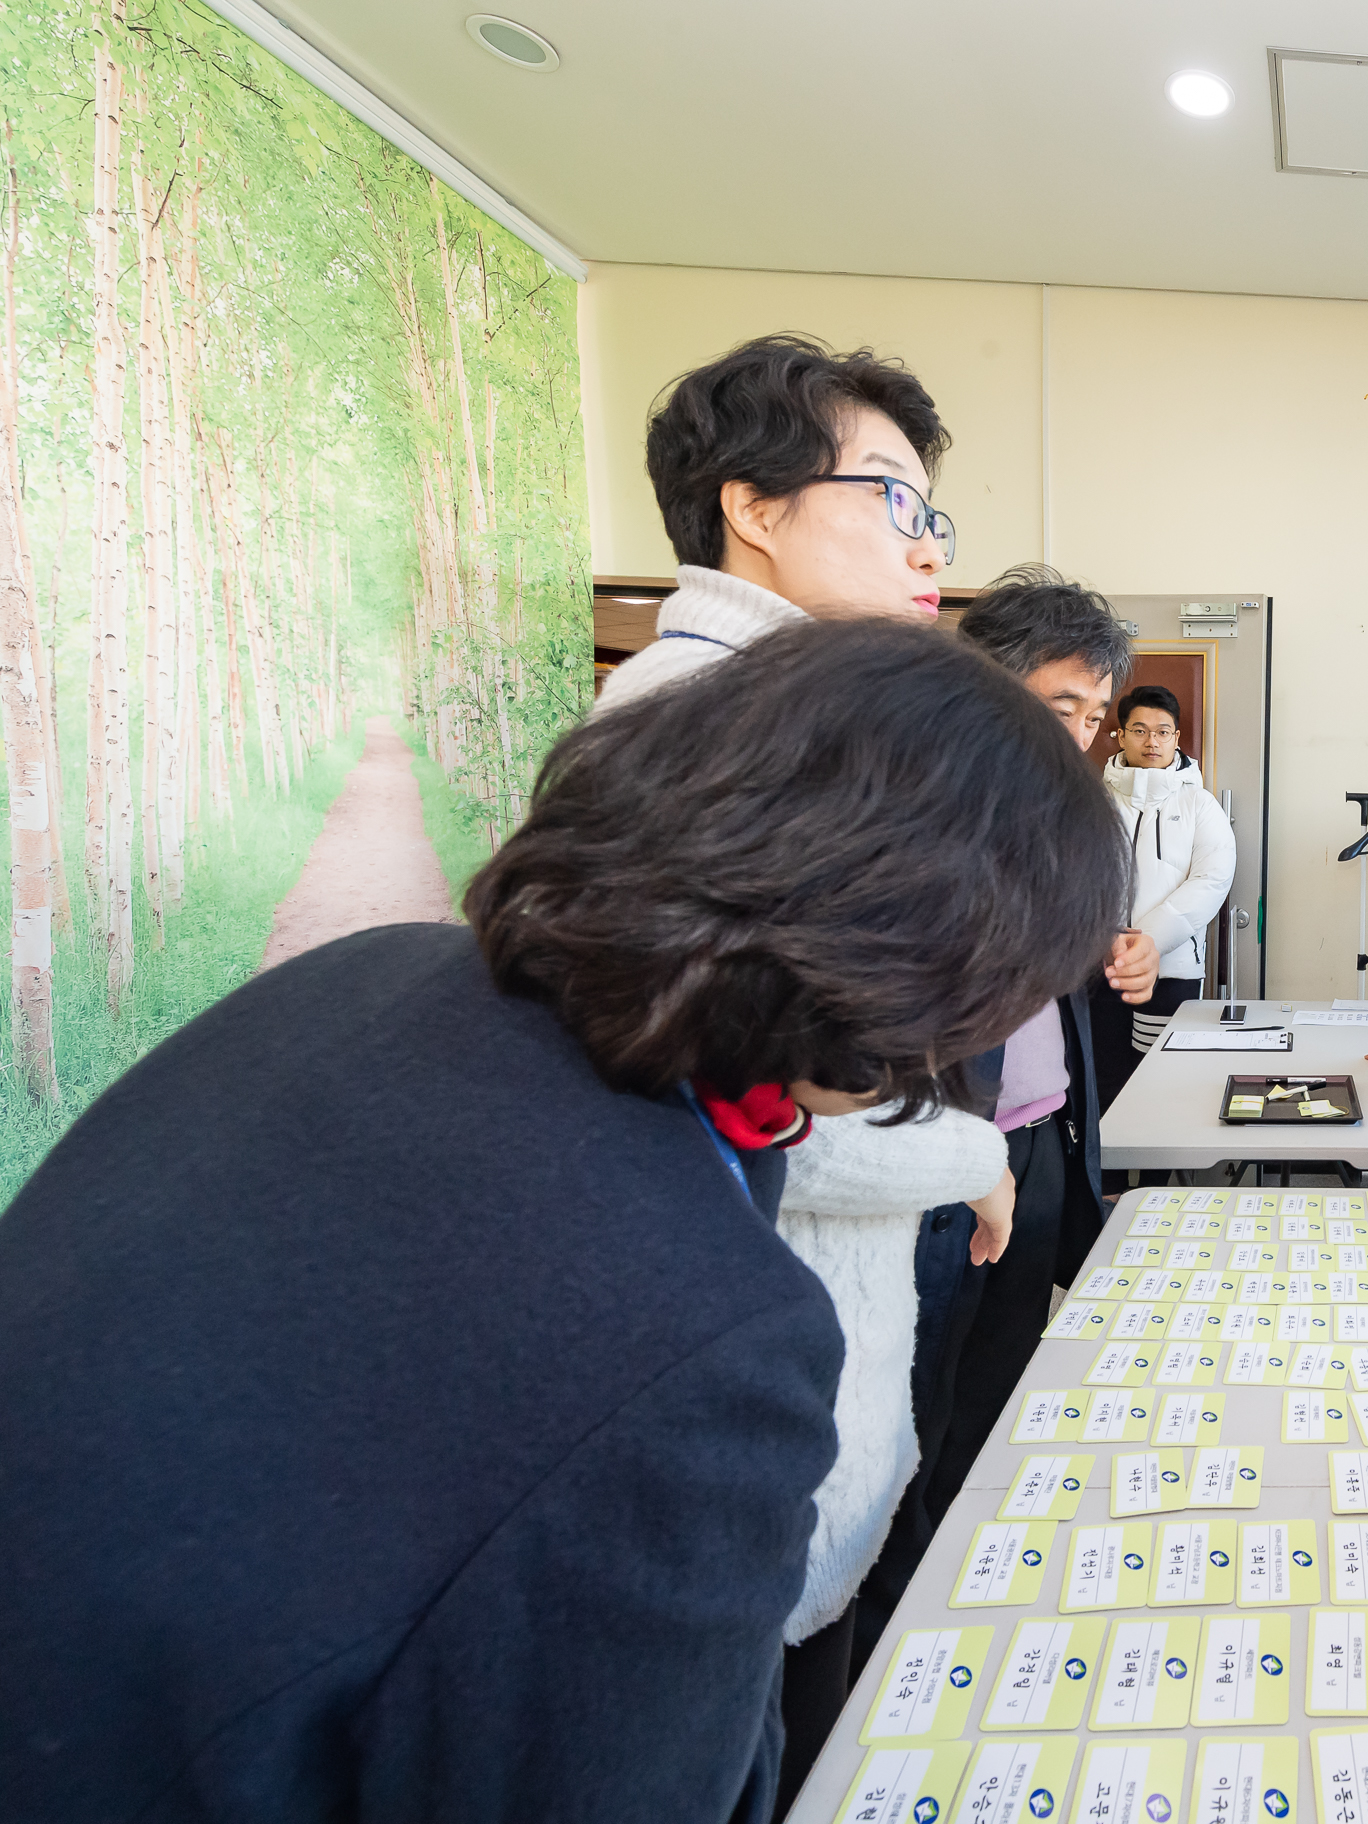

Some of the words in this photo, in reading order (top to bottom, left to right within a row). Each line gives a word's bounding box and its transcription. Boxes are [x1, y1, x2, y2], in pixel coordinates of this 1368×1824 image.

[1077, 1586, 1088, 1594] 님
[1250, 1583, 1260, 1591] 님
[1013, 1650, 1040, 1688] 강경일
[1118, 1649, 1140, 1687] 김태형
[896, 1658, 923, 1699] 정인숙
[1213, 1694, 1225, 1703] 님
[1006, 1699, 1017, 1708] 님
[1113, 1699, 1124, 1708] 님
[889, 1708, 900, 1718] 님
[1333, 1770, 1355, 1823] 김동근
